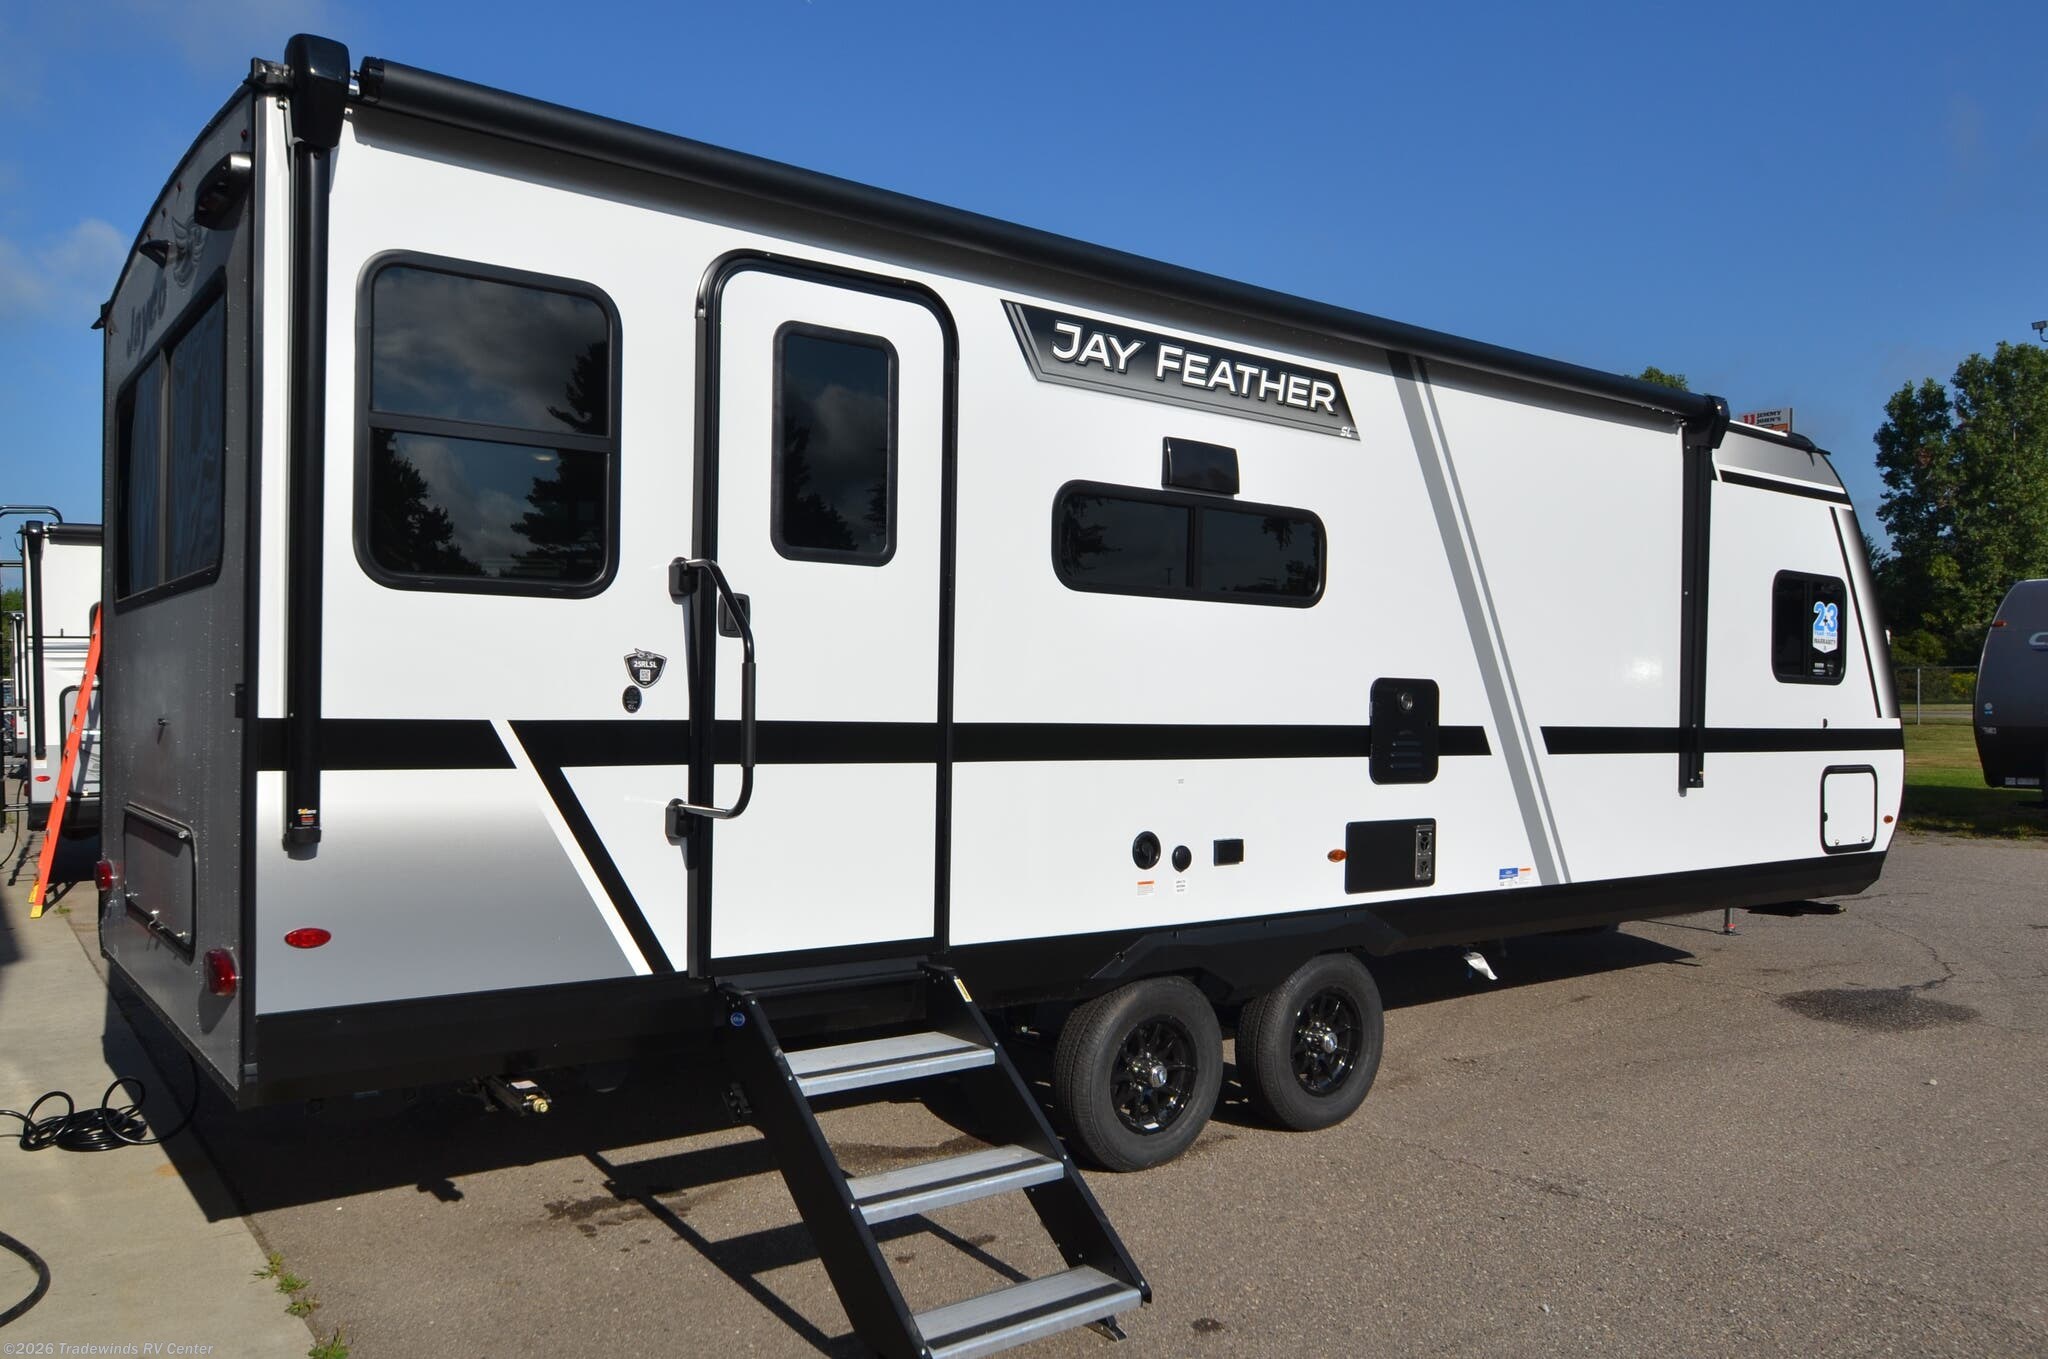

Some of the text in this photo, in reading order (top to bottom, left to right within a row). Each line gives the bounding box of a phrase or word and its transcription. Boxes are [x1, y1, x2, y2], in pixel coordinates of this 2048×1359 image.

[127, 277, 167, 359] Jayco
[1052, 321, 1338, 415] JAY FEATHER
[1340, 426, 1352, 437] SL
